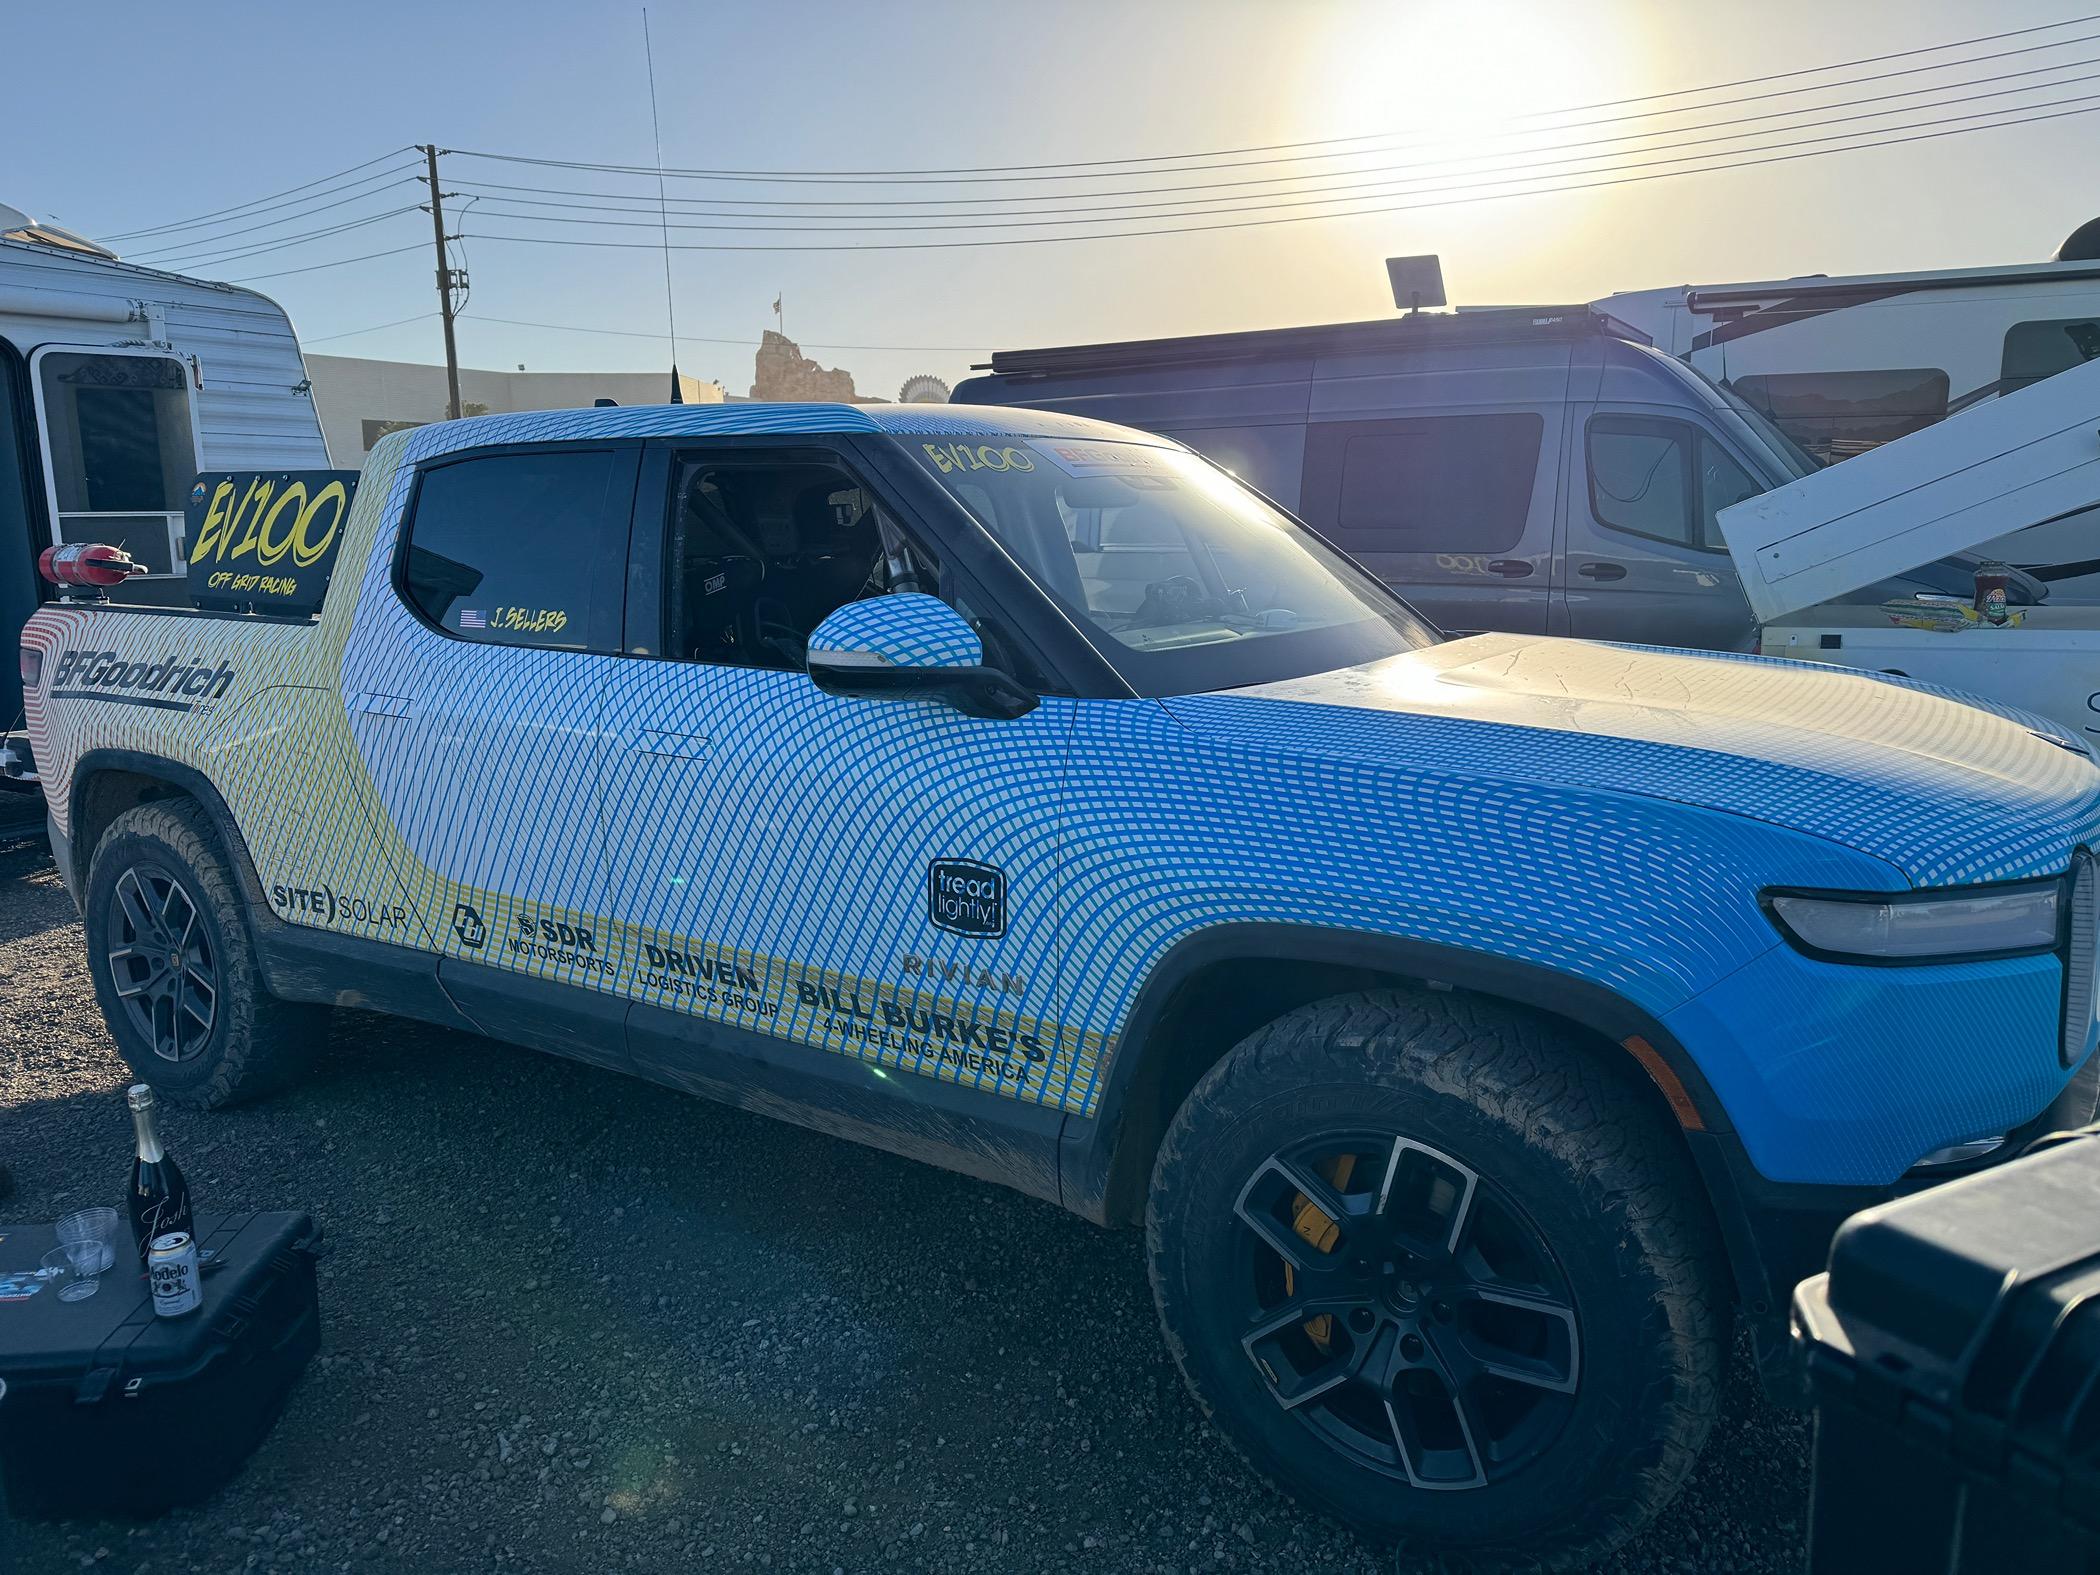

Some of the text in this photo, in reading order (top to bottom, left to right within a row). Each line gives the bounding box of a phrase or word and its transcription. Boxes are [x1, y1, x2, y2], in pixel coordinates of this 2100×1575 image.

[922, 443, 1035, 474] EV100
[190, 478, 346, 567] EV100
[208, 572, 297, 596] OFF GRID RACING
[704, 575, 725, 592] OMP
[52, 650, 236, 699] BFGoodrich
[938, 869, 995, 900] tread
[507, 938, 616, 976] MOTORSPORTS
[540, 918, 598, 953] SDR
[644, 943, 760, 993] DRIVEN
[902, 952, 1025, 997] RIVIAN
[637, 969, 780, 1018] LOGISTICS GROUP
[796, 979, 1047, 1063] BILL BURKE'S
[822, 1016, 1031, 1084] 4-WHEELING AMERICA
[139, 1191, 187, 1259] Josh
